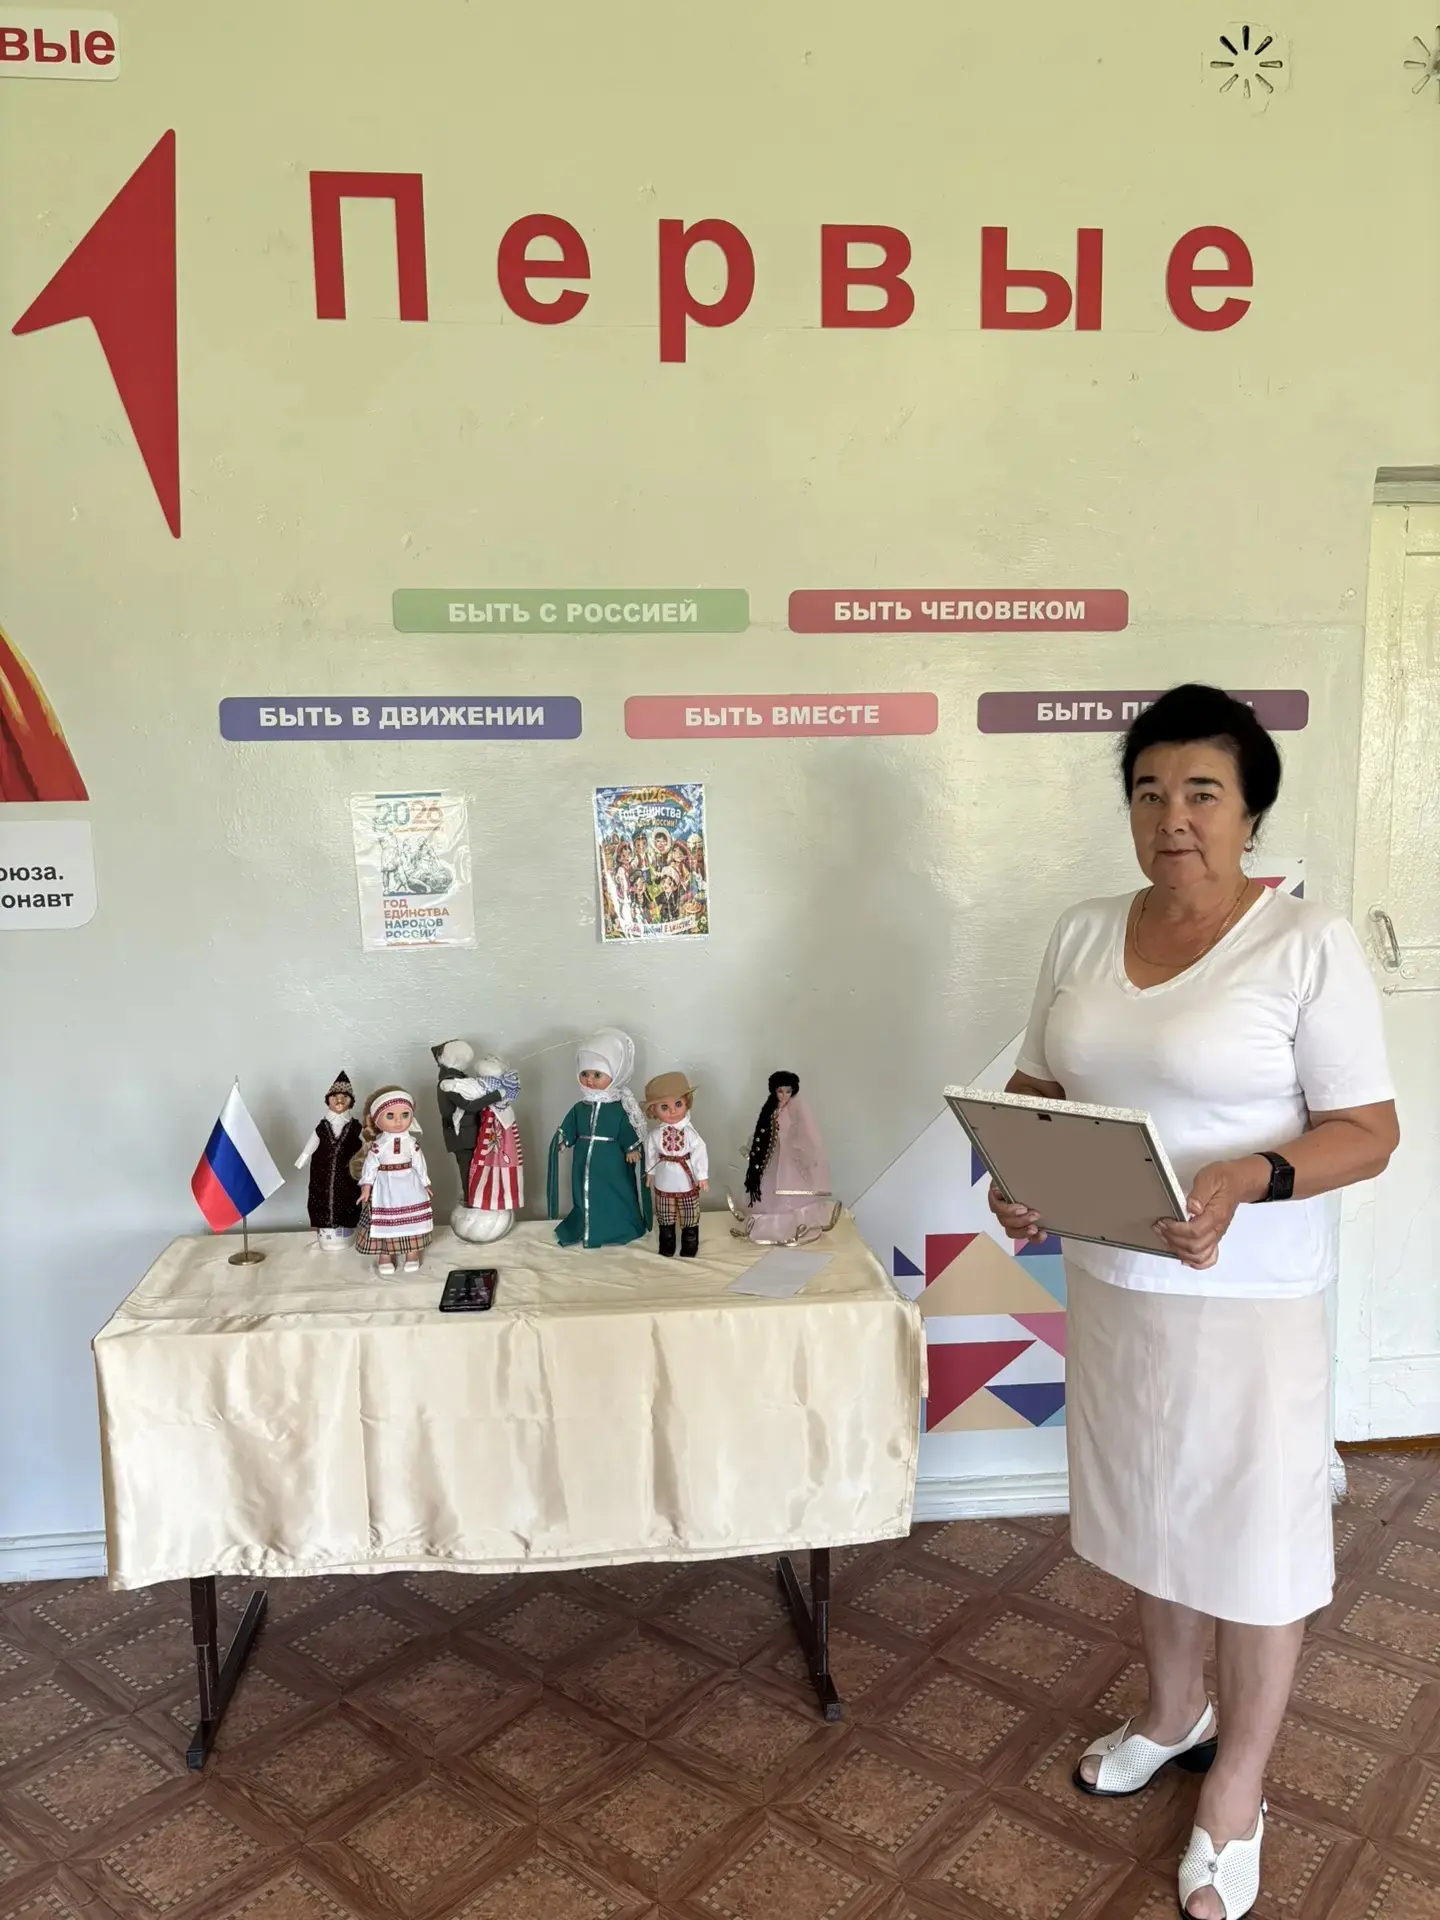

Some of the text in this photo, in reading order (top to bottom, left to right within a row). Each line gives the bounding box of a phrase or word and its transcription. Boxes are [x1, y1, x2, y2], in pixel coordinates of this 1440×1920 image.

[0, 27, 115, 65] вые
[309, 170, 1254, 363] Первые
[448, 598, 698, 623] БЫТЬ С РОССИЕЙ
[834, 600, 1085, 621] БЫТЬ ЧЕЛОВЕКОМ
[259, 706, 545, 730] БЫТЬ В ДВИЖЕНИИ
[685, 705, 880, 726] БЫТЬ ВМЕСТЕ
[1037, 701, 1113, 721] БЫТЬ
[632, 787, 667, 803] 2026
[373, 800, 444, 826] 2026
[1, 892, 75, 909] онавт
[383, 898, 409, 909] ГОД
[384, 907, 450, 920] ЕДИНСТВА
[385, 918, 444, 930] НАРОДОВ
[385, 928, 437, 940] РОССИИ
